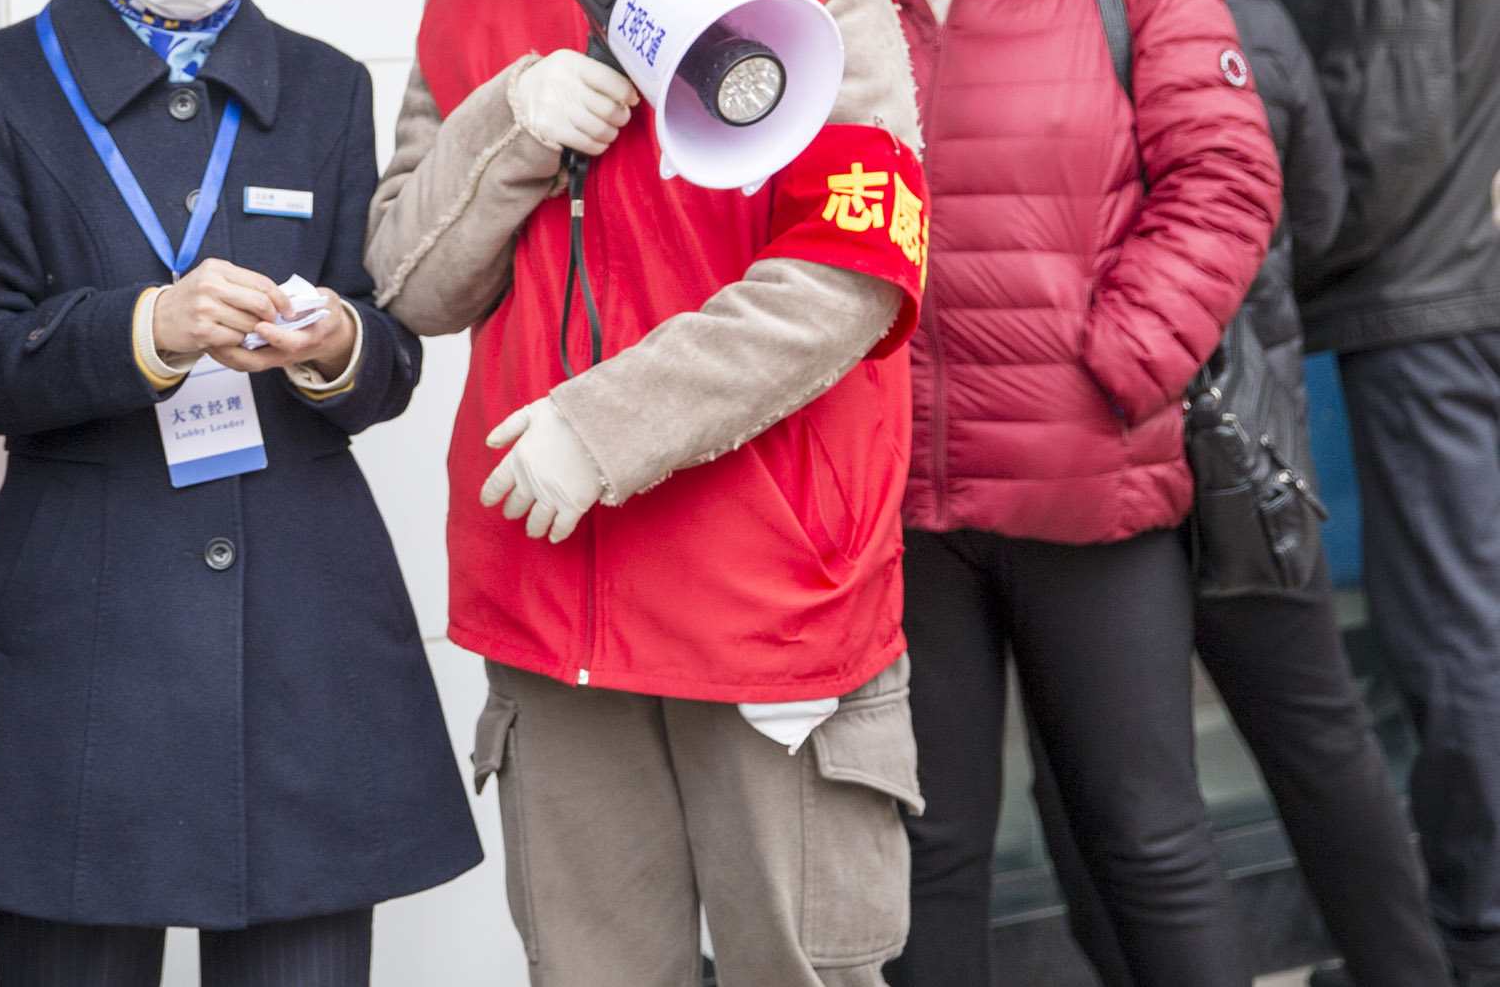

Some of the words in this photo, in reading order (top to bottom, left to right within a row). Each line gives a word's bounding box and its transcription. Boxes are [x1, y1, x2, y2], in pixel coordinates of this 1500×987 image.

[618, 0, 666, 67] 文明交通
[169, 395, 242, 426] 大堂经理
[174, 428, 205, 440] Lobby
[209, 418, 245, 432] Leader
